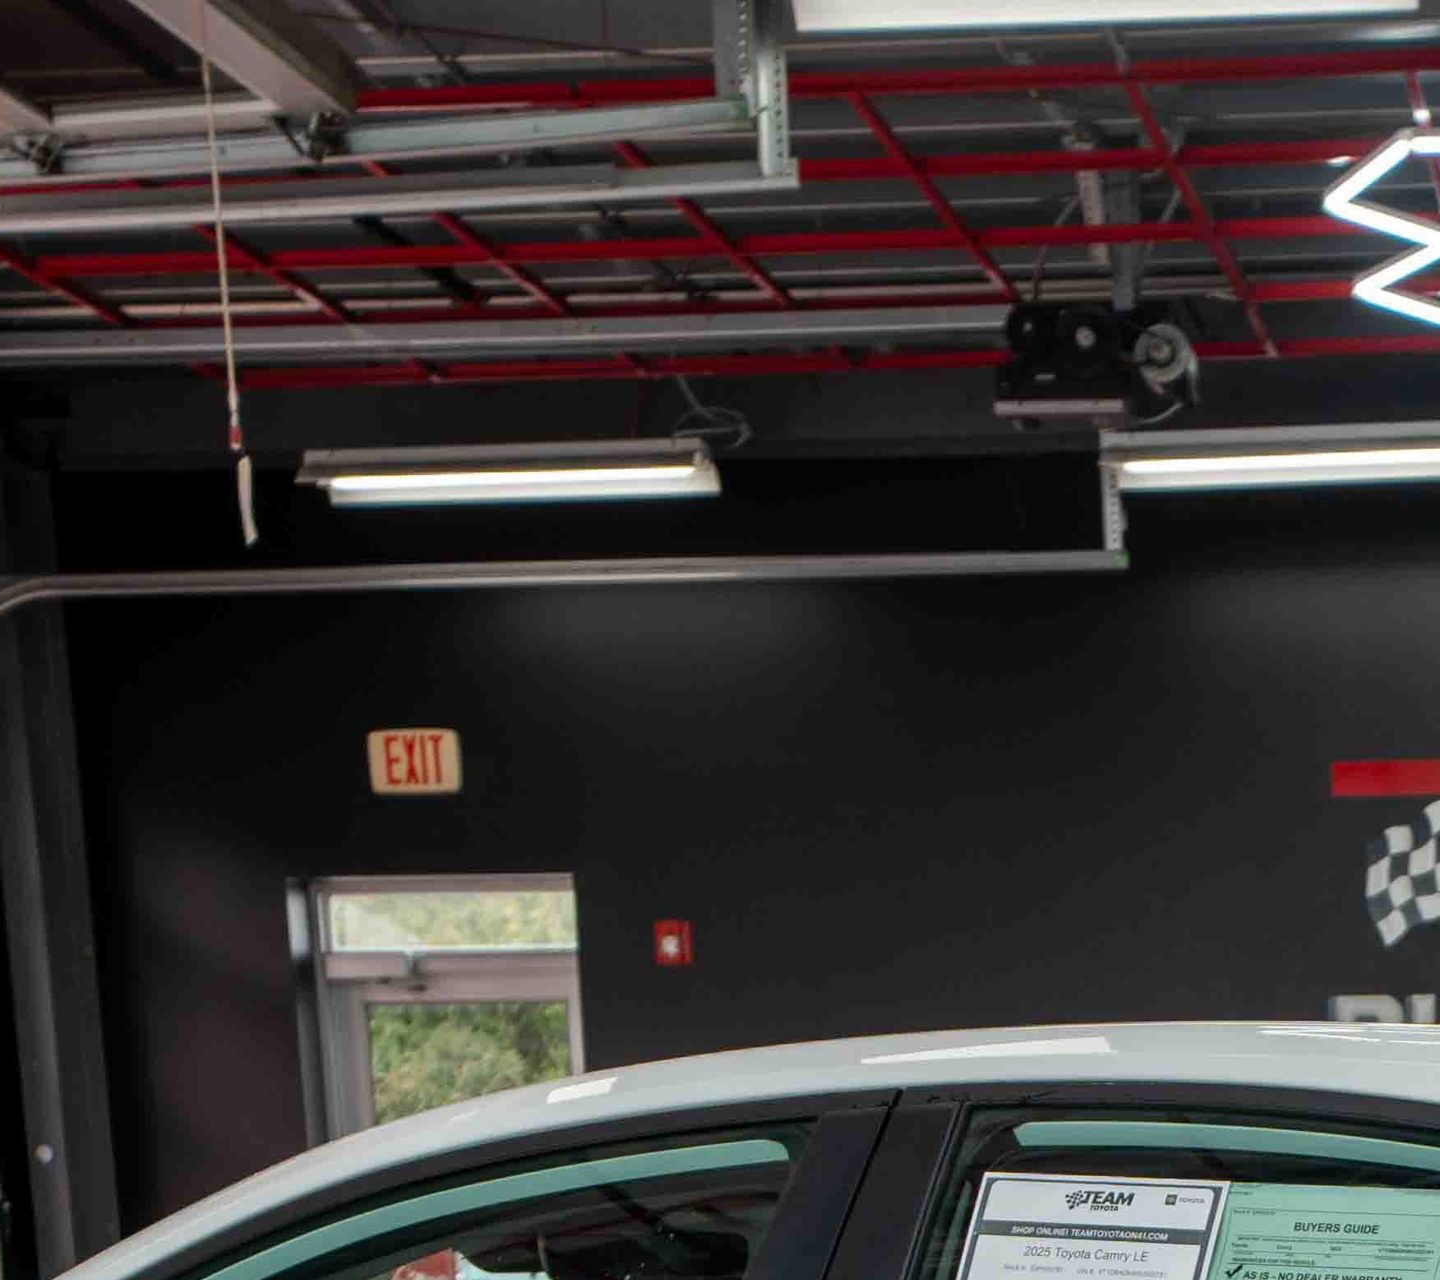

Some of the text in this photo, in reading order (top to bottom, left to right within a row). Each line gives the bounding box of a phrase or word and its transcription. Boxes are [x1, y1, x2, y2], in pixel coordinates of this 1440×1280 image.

[383, 734, 443, 785] EXIT
[1082, 1190, 1136, 1207] TEAM
[1088, 1204, 1119, 1212] TOYOTA
[1011, 1226, 1035, 1235] SHOP
[1293, 1221, 1380, 1235] BUYERS GUIDE
[1023, 1245, 1150, 1264] 2025 Toyota Camry LE
[1242, 1271, 1258, 1280] AS
[1259, 1271, 1271, 1280] IS
